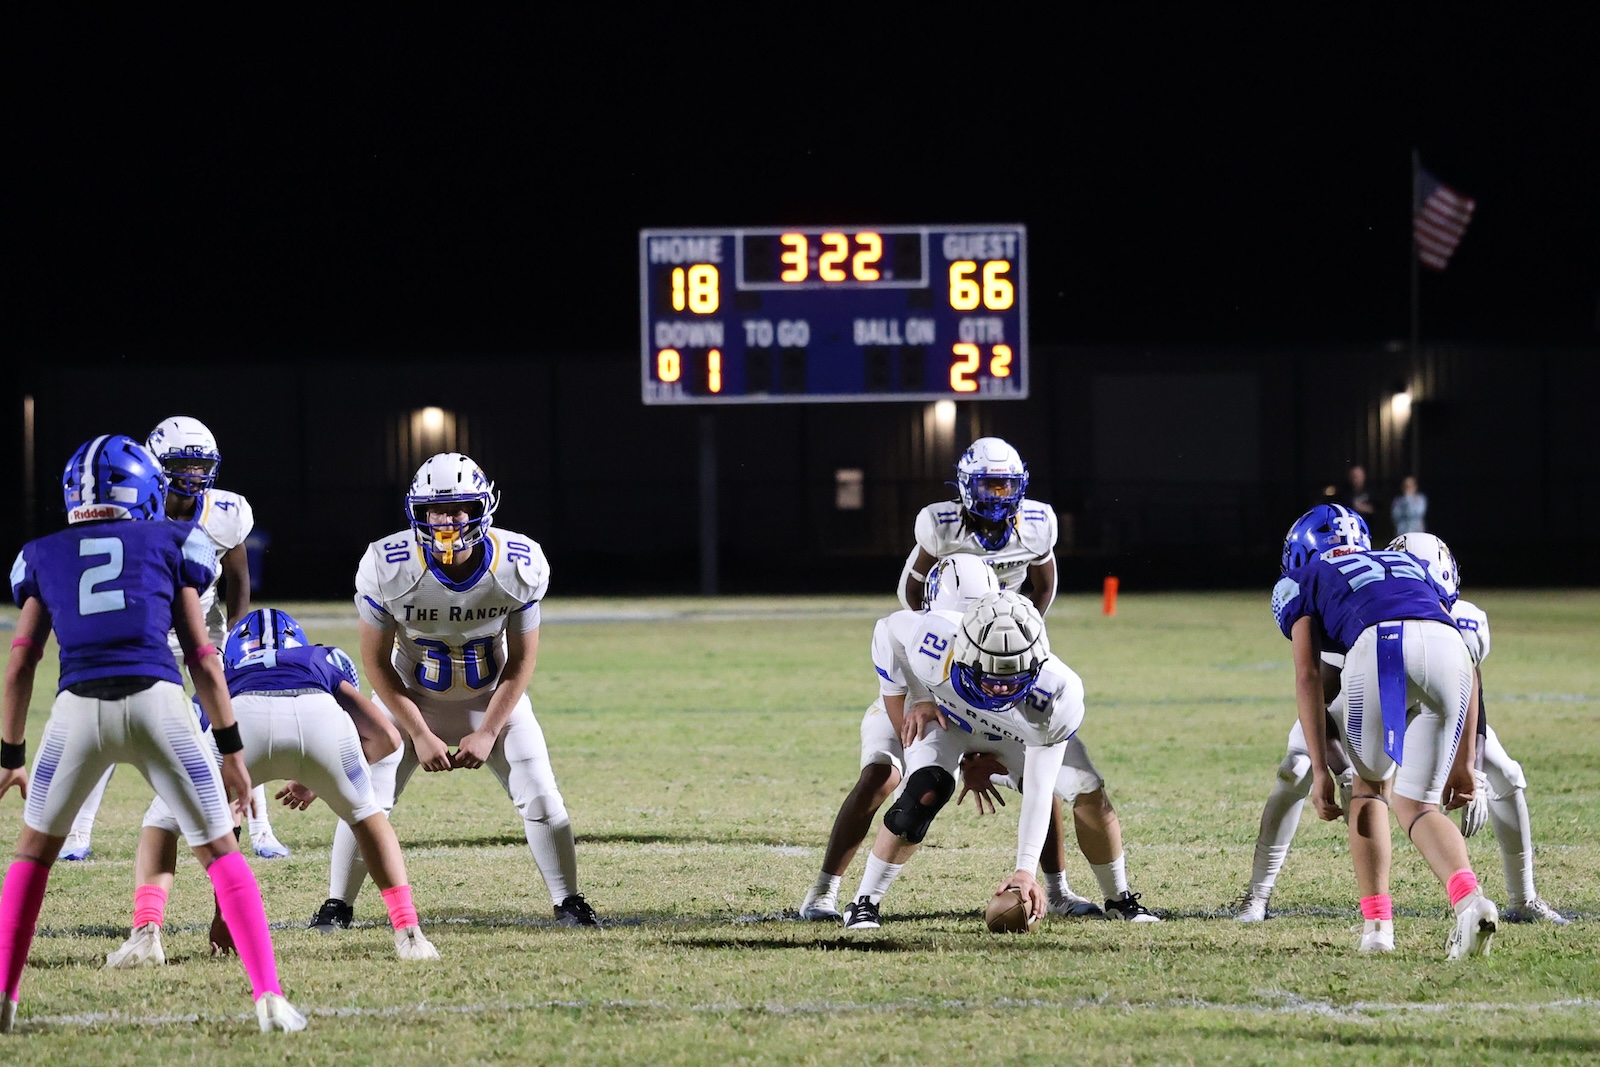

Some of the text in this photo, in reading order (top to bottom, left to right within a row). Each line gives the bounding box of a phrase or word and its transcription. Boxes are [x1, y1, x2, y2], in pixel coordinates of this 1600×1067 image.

[650, 237, 723, 263] HOME
[943, 234, 1016, 260] GUEST
[672, 263, 720, 314] 18
[949, 260, 1014, 311] 66
[655, 320, 725, 348] DOWN
[743, 319, 810, 347] TO GO
[853, 318, 936, 345] BALL ON
[958, 316, 1004, 343] QTR
[74, 507, 115, 520] Riddell
[215, 501, 235, 511] 4
[938, 511, 959, 525] 11
[1023, 510, 1044, 522] 11
[384, 540, 410, 564] 30
[507, 541, 531, 566] 30
[79, 537, 126, 616] 2
[1324, 551, 1426, 592] 33
[1457, 617, 1479, 632] 8
[919, 632, 947, 660] 21
[413, 635, 498, 692] 30
